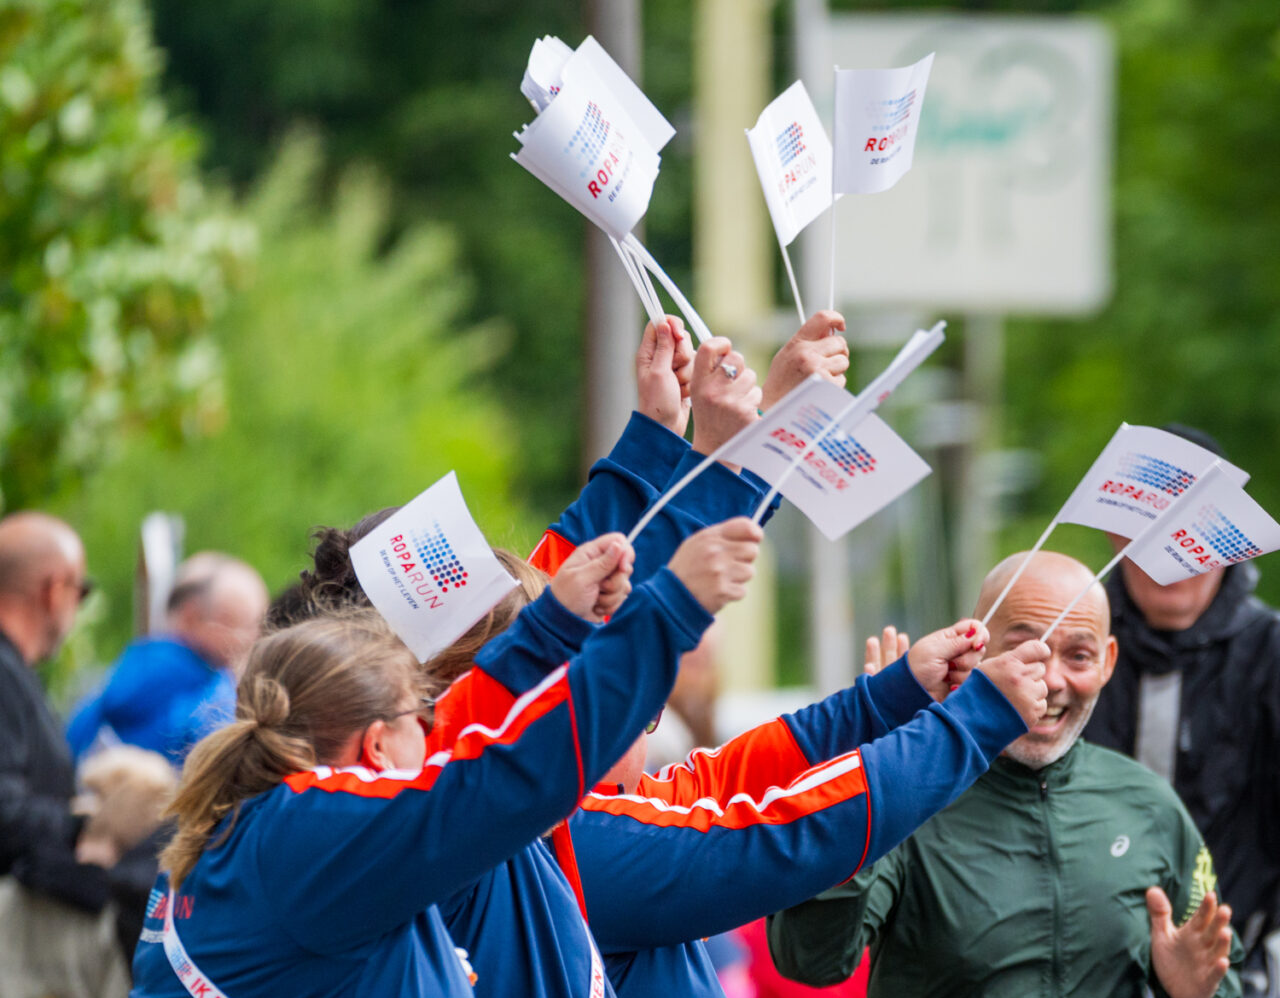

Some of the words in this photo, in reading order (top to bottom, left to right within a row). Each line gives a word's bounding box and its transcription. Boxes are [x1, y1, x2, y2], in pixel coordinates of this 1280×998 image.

[1099, 480, 1171, 511] ROPARU
[390, 533, 445, 609] ROPARUN
[1171, 528, 1224, 571] ROPAR
